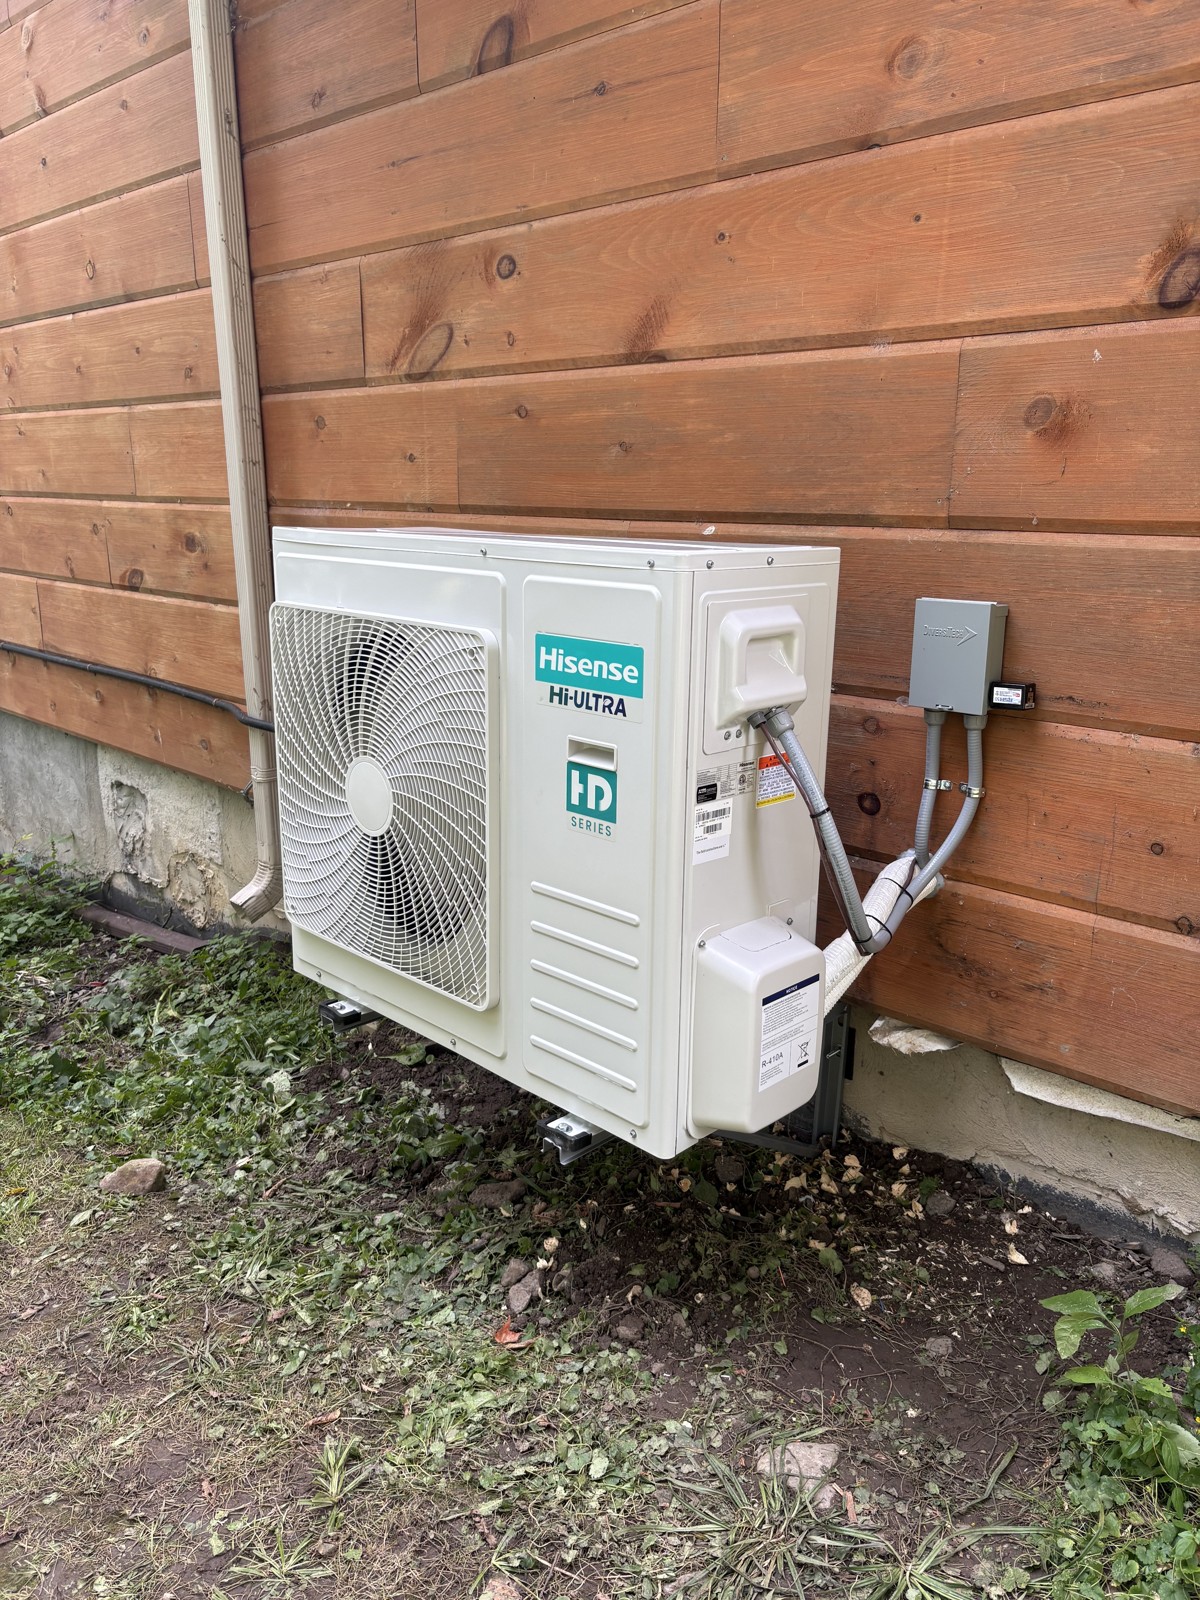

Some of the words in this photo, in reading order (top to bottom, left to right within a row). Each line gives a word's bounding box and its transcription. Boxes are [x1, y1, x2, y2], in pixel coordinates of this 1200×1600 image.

[539, 646, 639, 684] Hisense
[570, 769, 613, 812] HD
[571, 816, 612, 837] SERIES
[761, 1051, 784, 1069] R-410A
